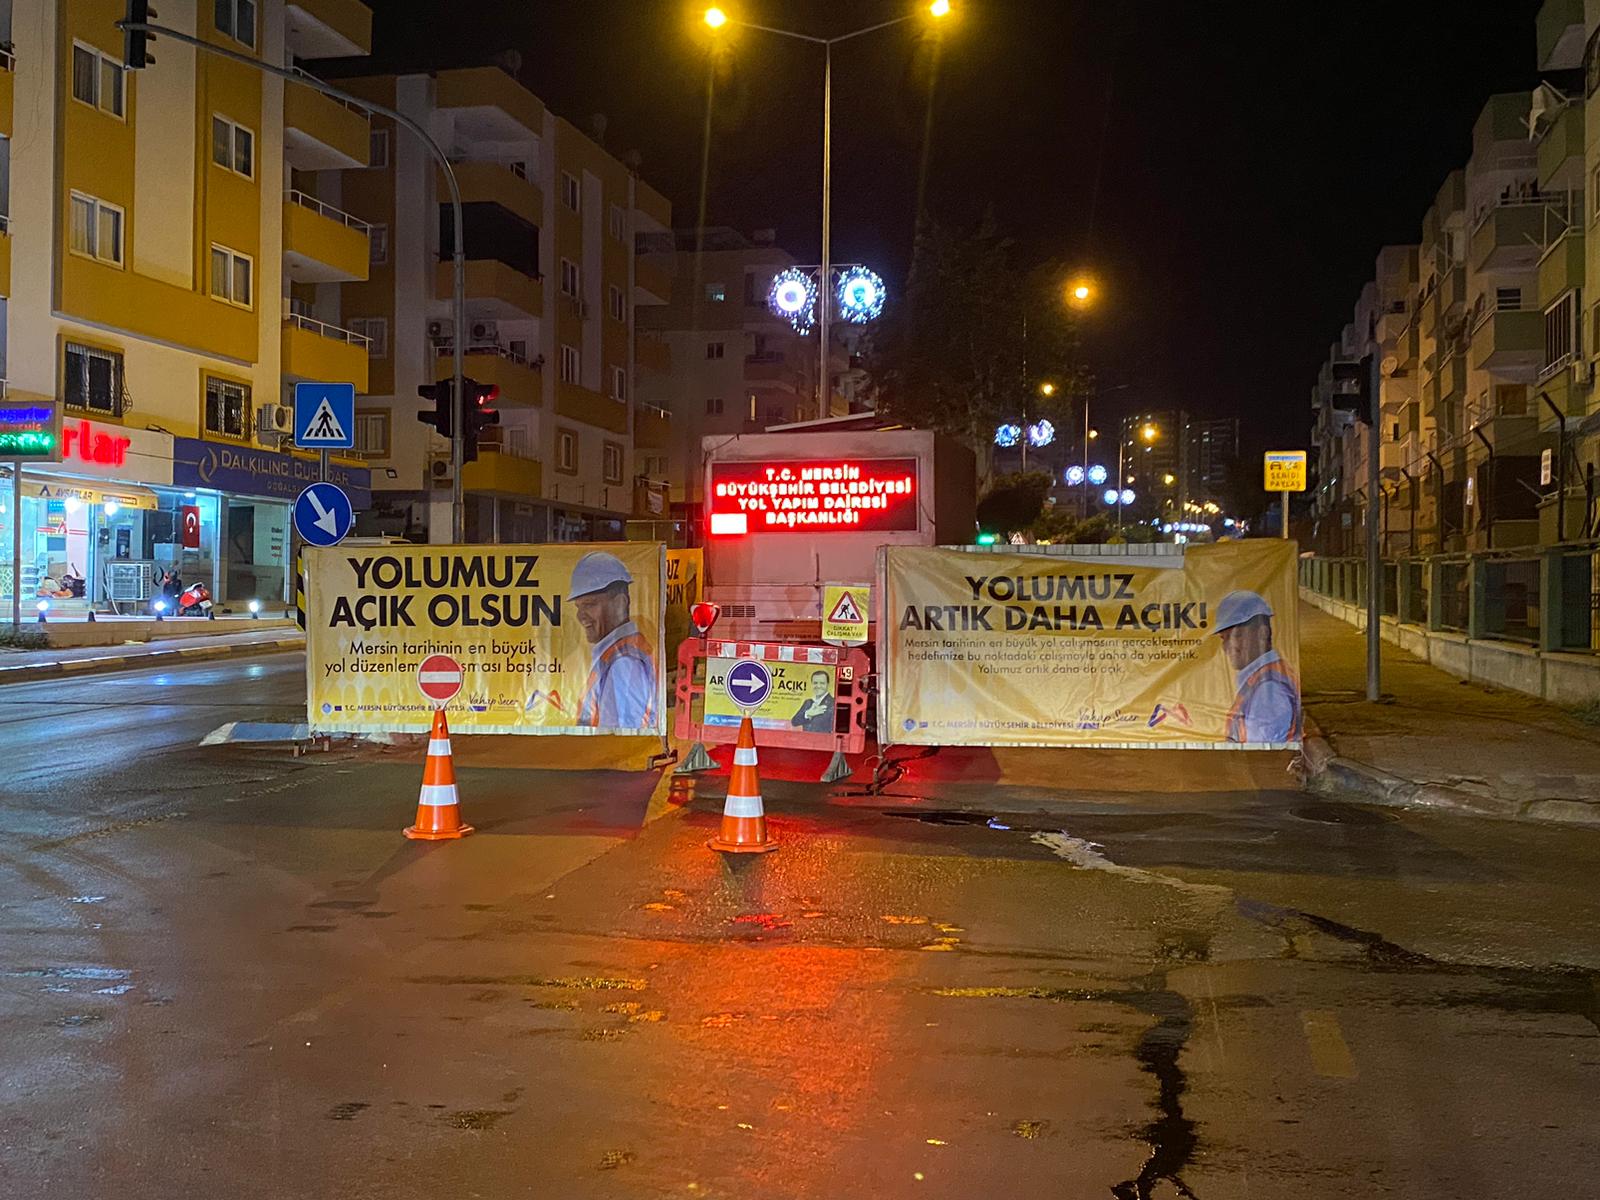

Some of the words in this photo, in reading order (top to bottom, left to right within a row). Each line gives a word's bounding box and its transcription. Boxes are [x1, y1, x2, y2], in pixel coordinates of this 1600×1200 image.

[63, 420, 129, 465] rlar
[766, 468, 796, 480] T.C.
[801, 464, 860, 480] MERSİN
[716, 481, 815, 498] BÜYÜKŞEHİR
[819, 477, 911, 495] BELEDİYESİ
[738, 498, 767, 510] YOL
[771, 498, 819, 510] YAPIM
[824, 493, 887, 509] DAİRESİ
[766, 508, 859, 527] BAŞKANLIĞI
[347, 555, 540, 589] YOLUMUZ
[965, 574, 1135, 601] YOLUMUZ
[329, 594, 416, 631] AÇIK
[427, 593, 561, 627] OLSUN
[900, 605, 993, 631] ARTIK
[1005, 605, 1105, 630] DAHA
[1115, 602, 1208, 632] AÇIK!
[350, 640, 398, 655] Mersin
[403, 638, 462, 654] tarihinin
[468, 644, 486, 654] en
[492, 639, 536, 658] büyük
[905, 638, 939, 648] Mersin
[942, 638, 986, 648] tarihinin
[989, 640, 1003, 648] en
[1006, 638, 1037, 650] büyük
[1040, 638, 1056, 650] yol
[1059, 638, 1119, 649] çalışmasını
[1122, 638, 1202, 650] gerçekleştirme
[908, 651, 964, 661] hedefimize
[967, 651, 981, 661] bu
[984, 651, 1036, 661] noktadaki
[1039, 651, 1095, 662] çalışmayla
[1099, 650, 1127, 660] daha
[1130, 650, 1144, 660] da
[325, 658, 345, 677] yol
[350, 658, 419, 673] düzenlem
[461, 660, 501, 675] şması
[506, 658, 565, 675] başladı.
[978, 664, 1022, 674] Yolumuz
[1025, 664, 1049, 674] artık
[1052, 664, 1080, 674] daha
[1083, 664, 1097, 674] da
[778, 680, 807, 692] AÇIK!
